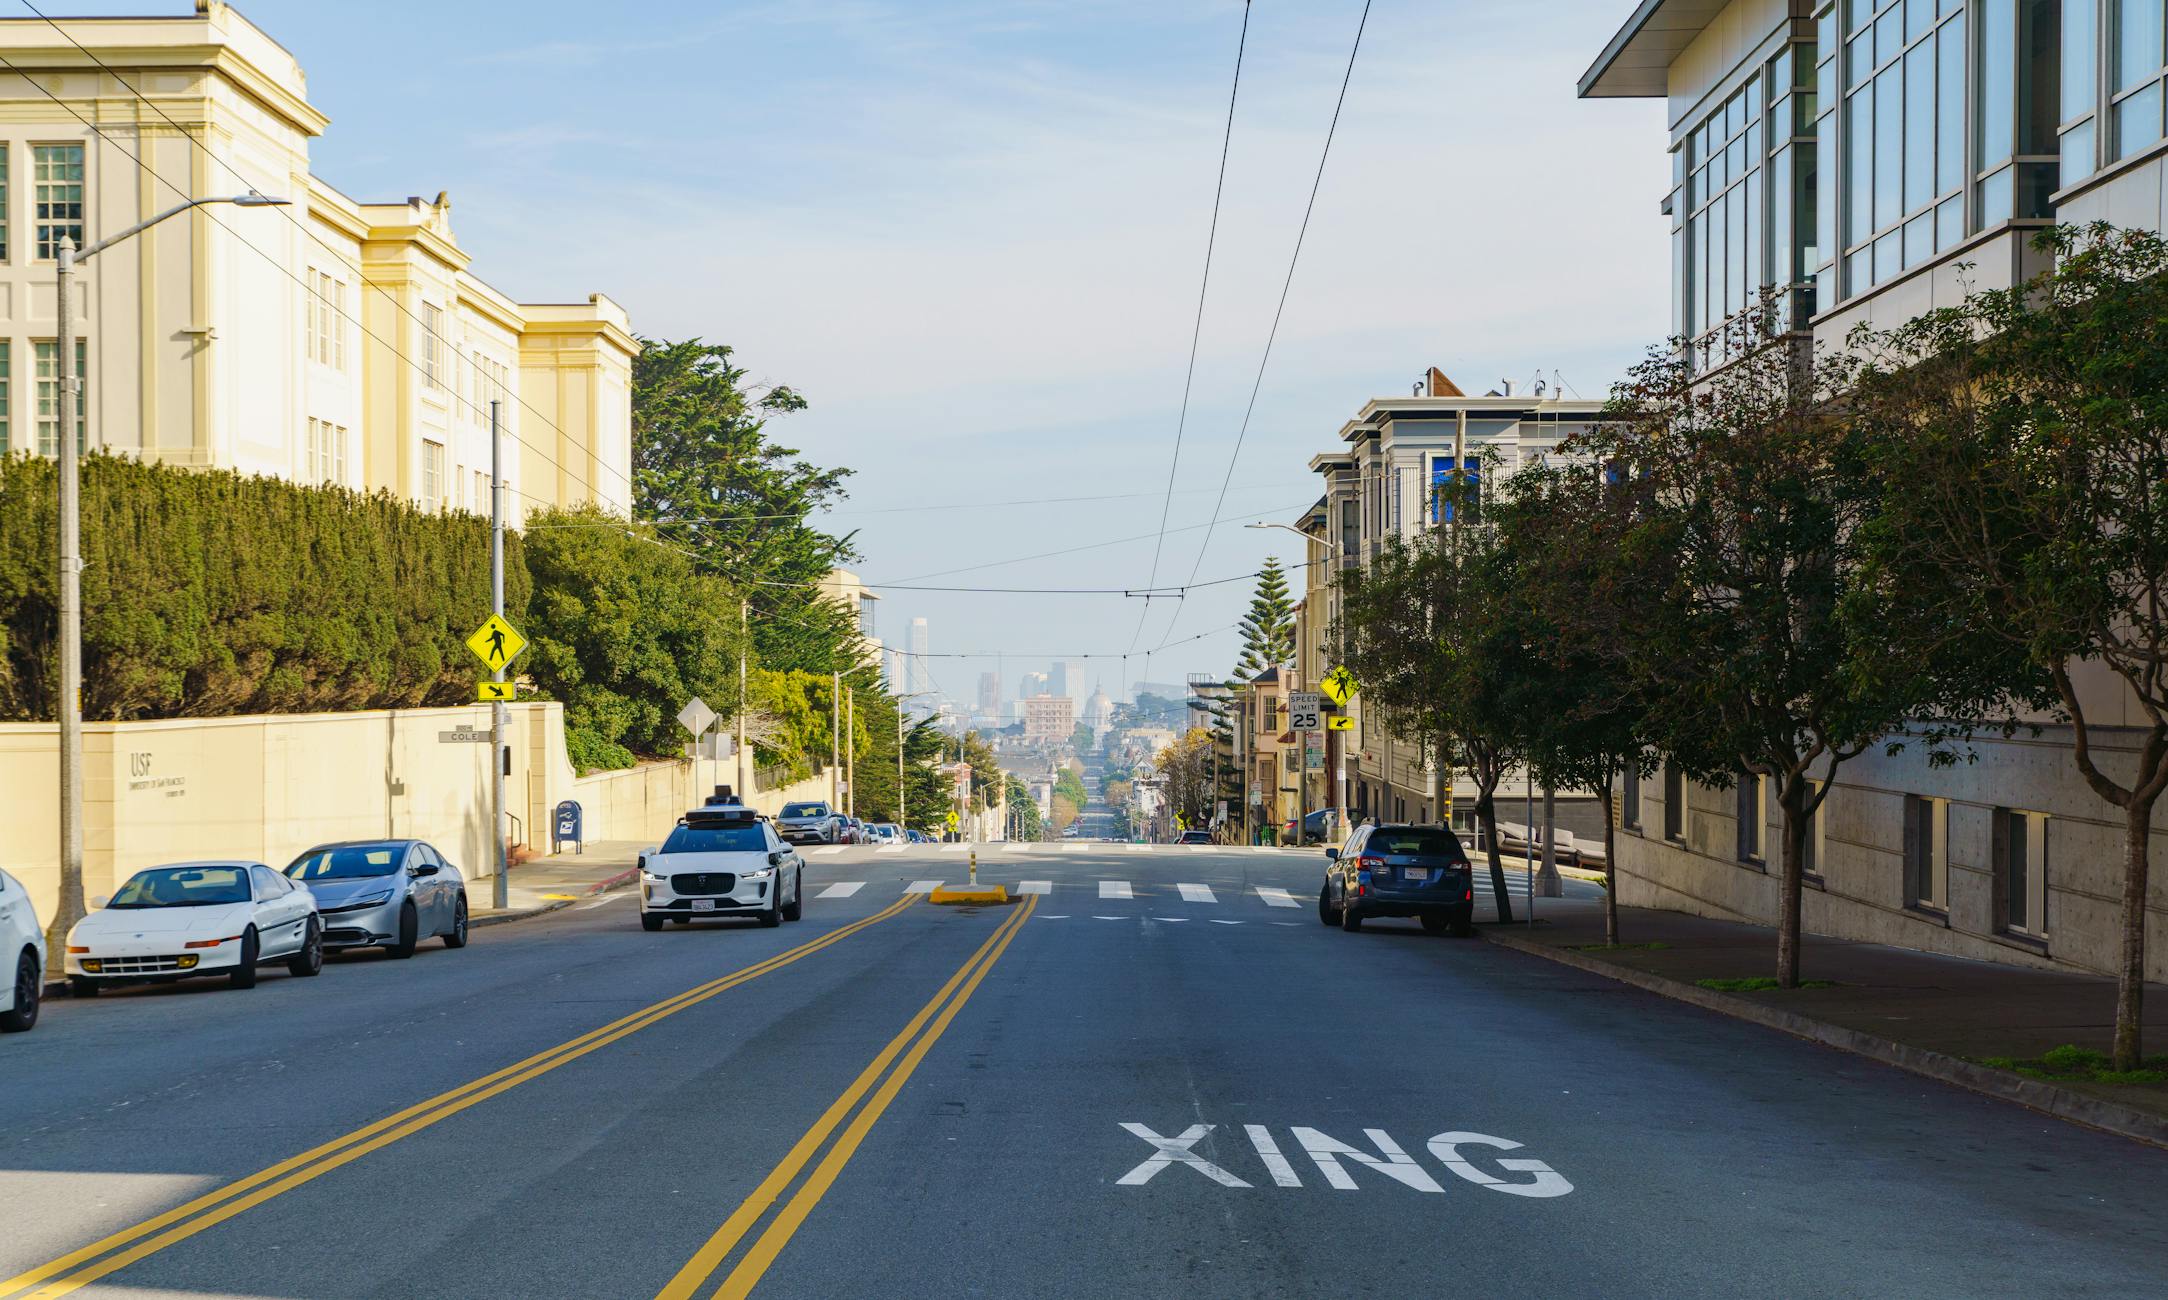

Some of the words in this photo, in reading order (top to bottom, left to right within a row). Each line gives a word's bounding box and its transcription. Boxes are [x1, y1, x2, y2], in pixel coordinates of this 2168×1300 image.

[1290, 695, 1318, 703] SPEED
[1293, 704, 1315, 712] LIMIT
[1293, 713, 1317, 728] 25
[451, 733, 478, 741] COLE
[130, 752, 152, 777] USF
[1115, 1122, 1575, 1198] XING
